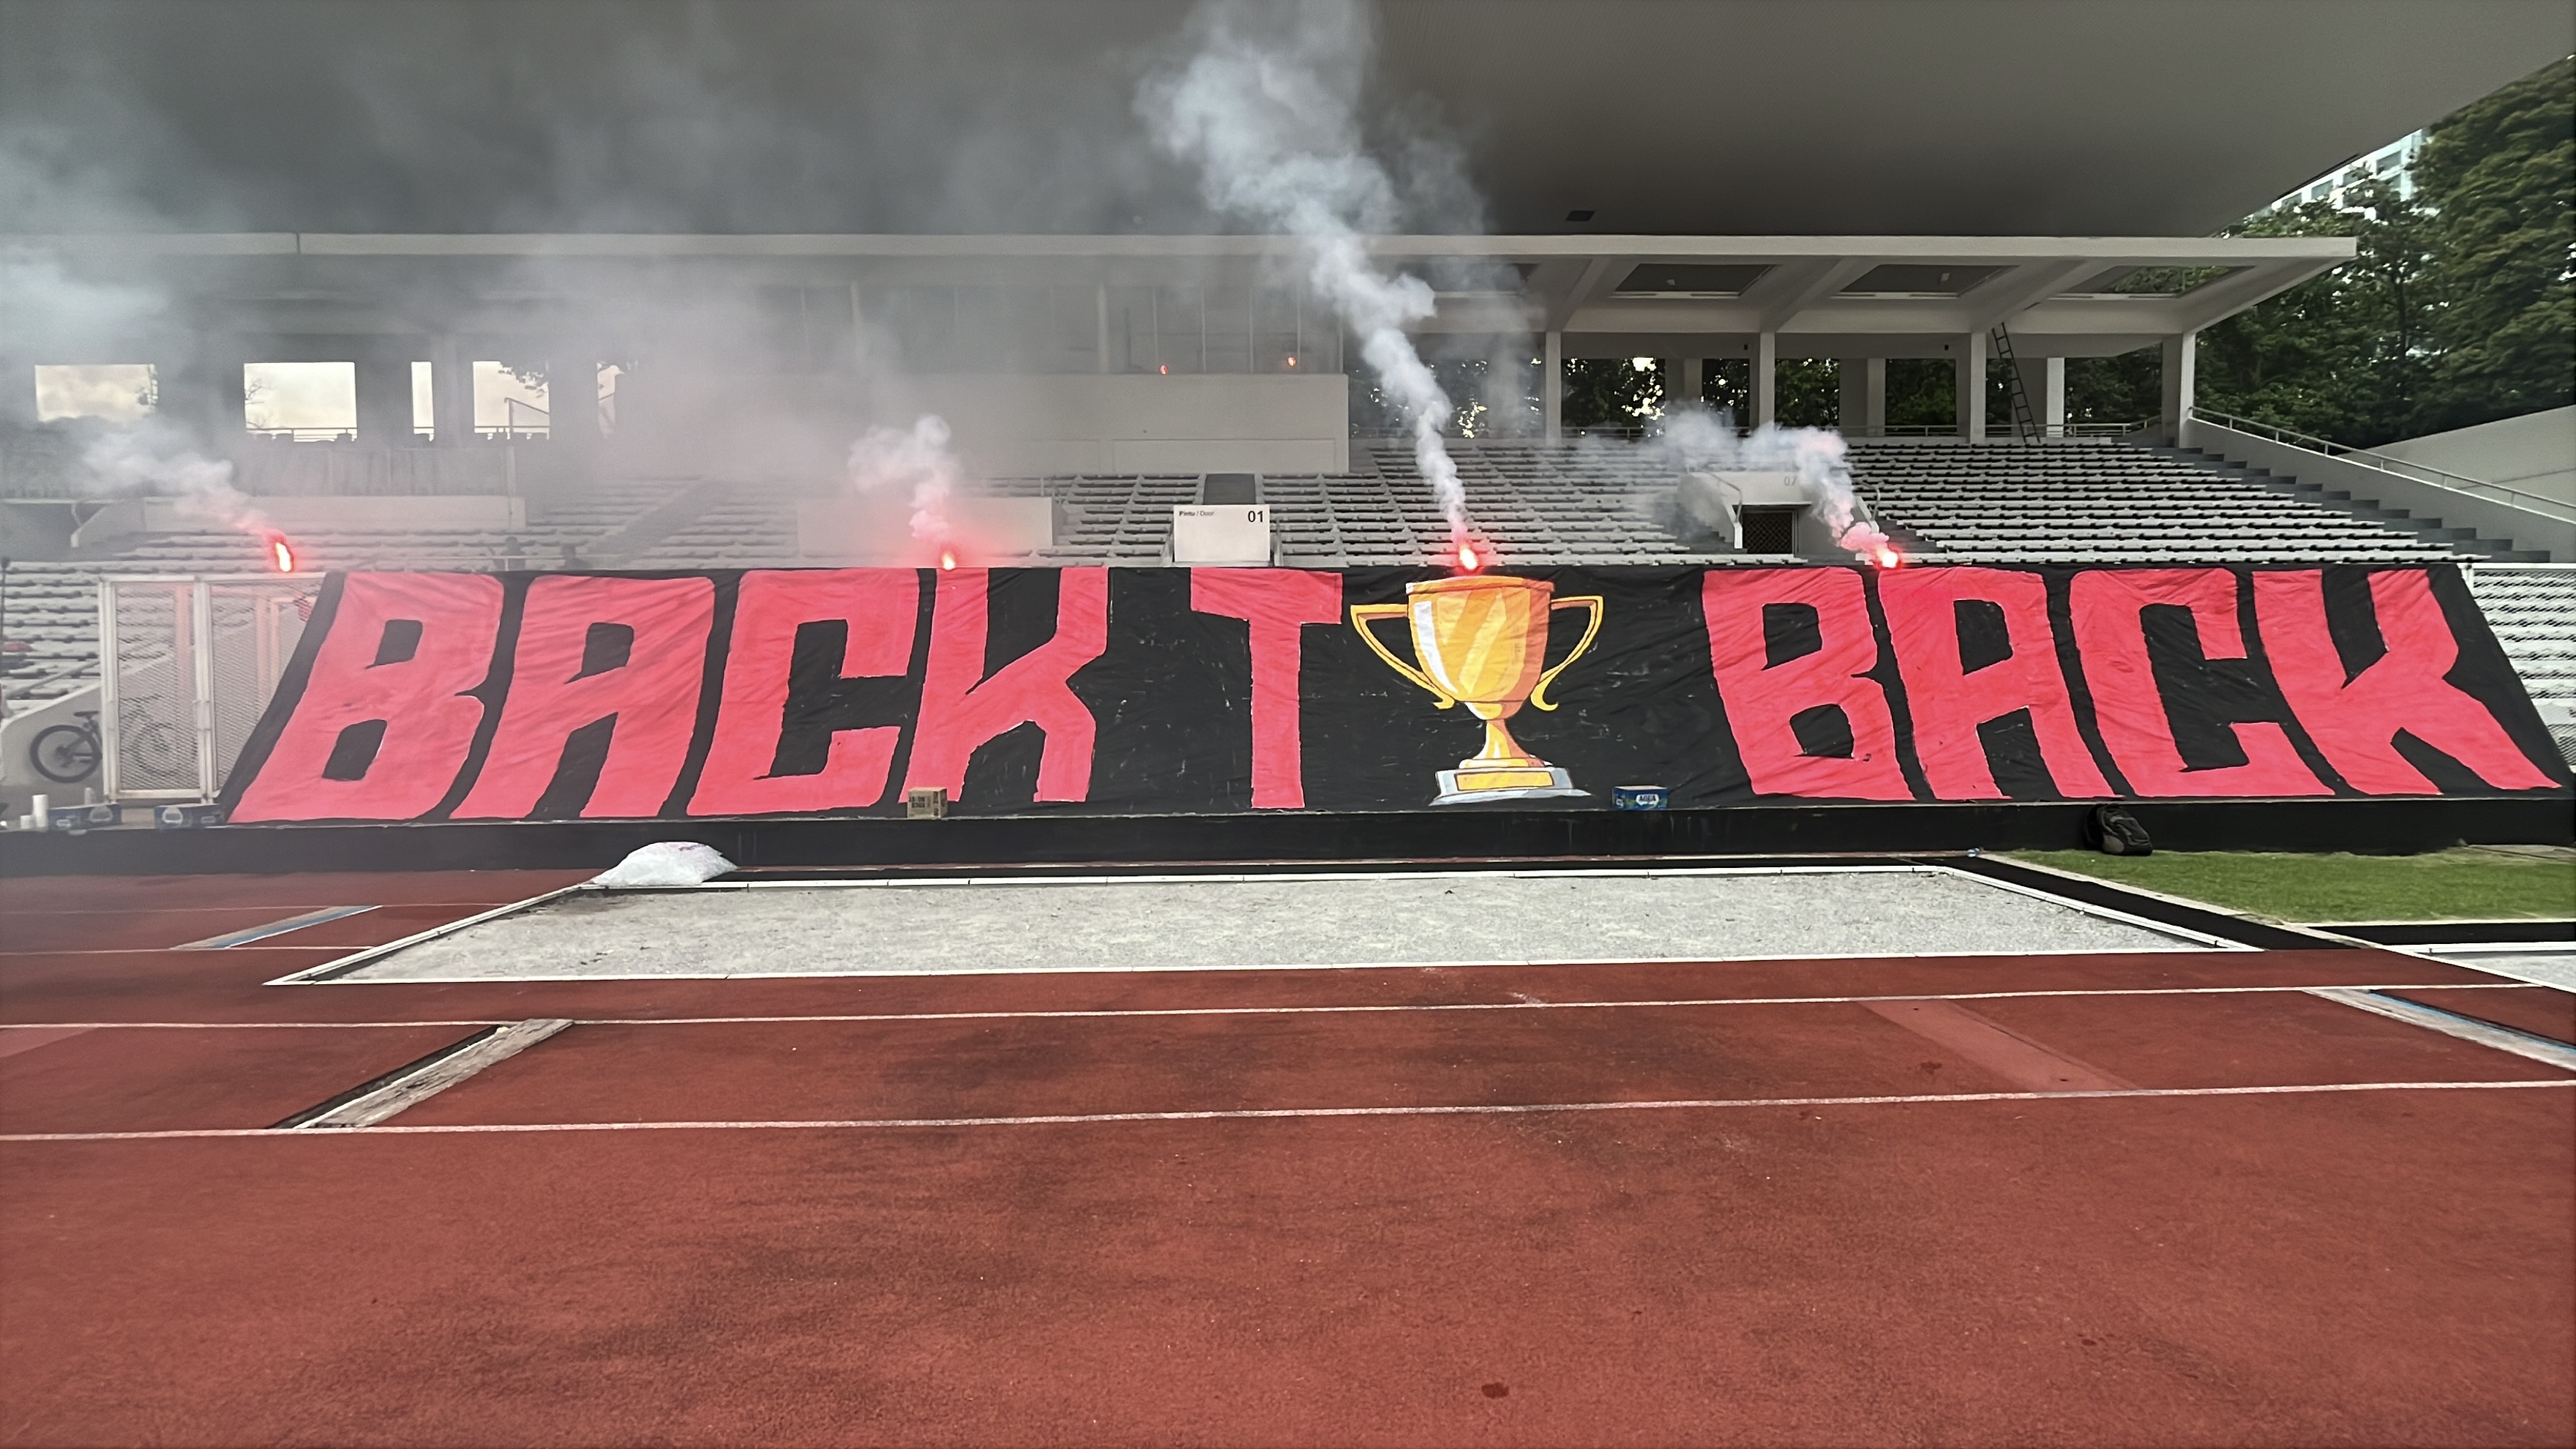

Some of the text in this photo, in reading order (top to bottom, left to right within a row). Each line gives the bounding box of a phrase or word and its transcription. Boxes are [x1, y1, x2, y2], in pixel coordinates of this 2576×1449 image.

[1248, 511, 1263, 523] 01
[227, 566, 2561, 823] BACK T BACK
